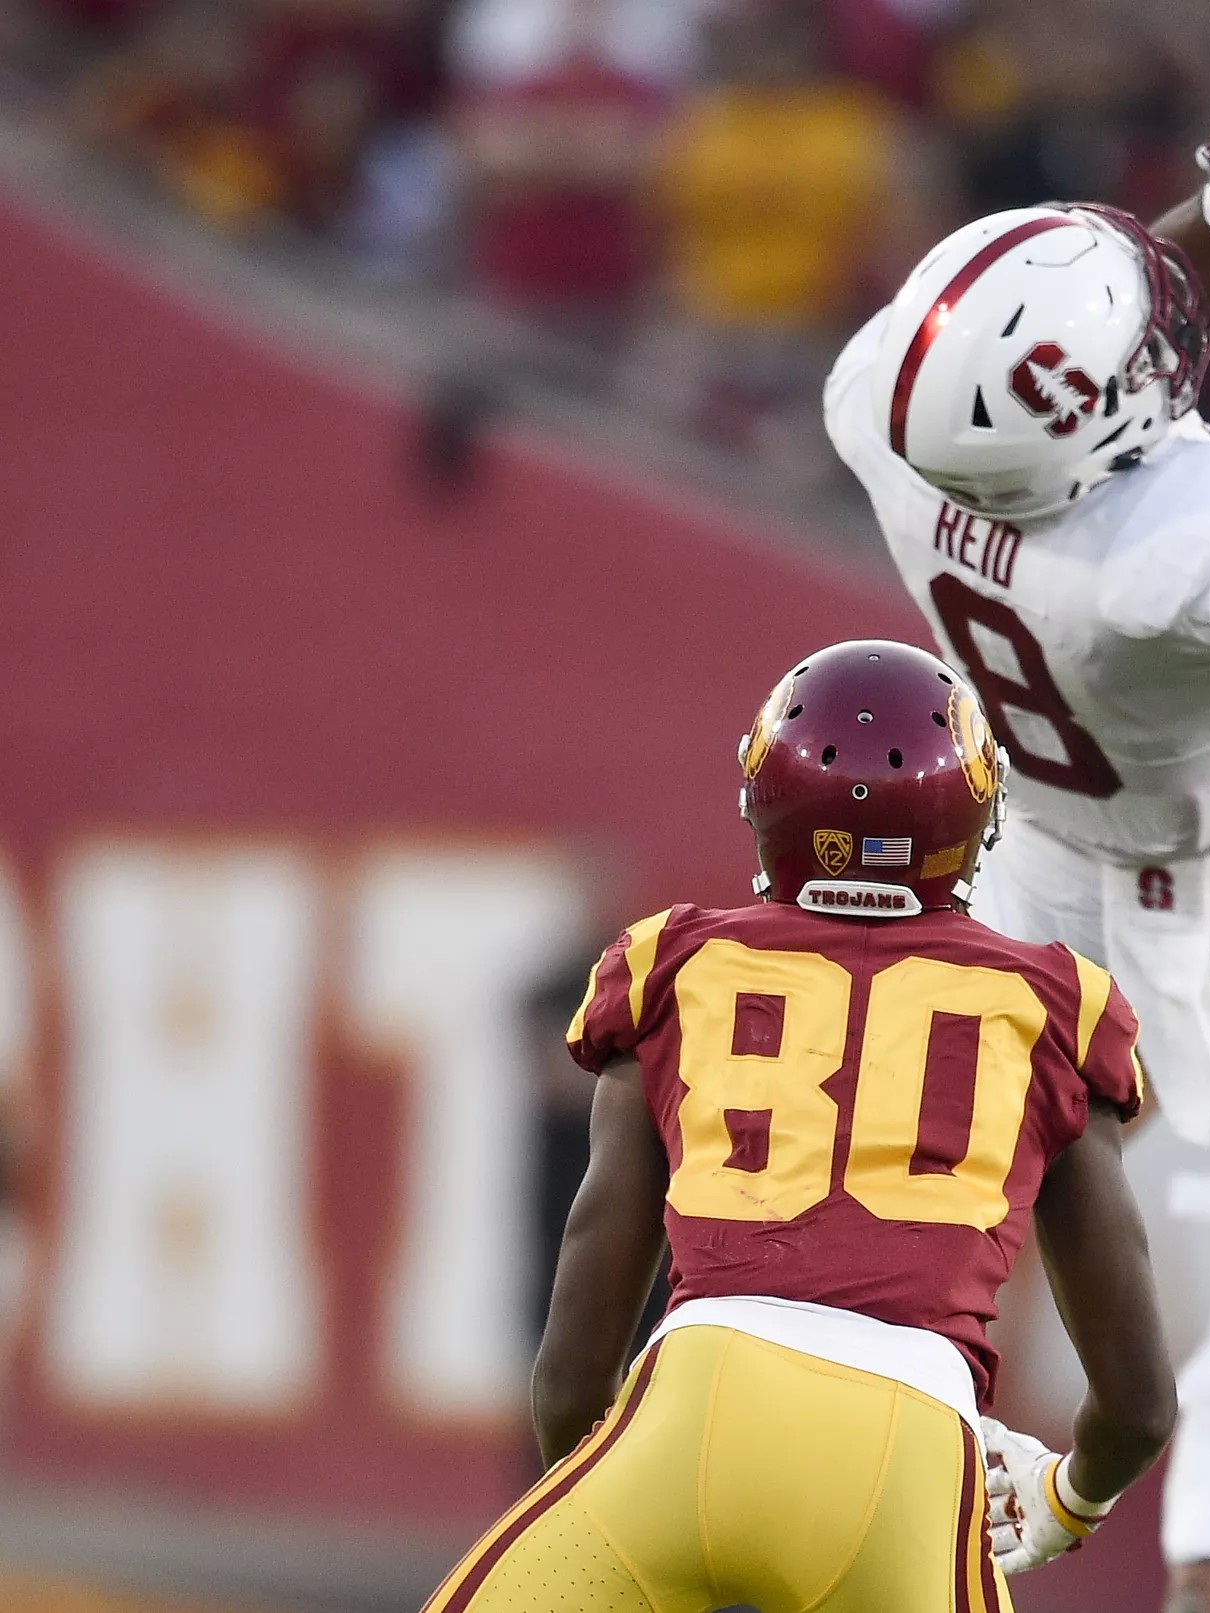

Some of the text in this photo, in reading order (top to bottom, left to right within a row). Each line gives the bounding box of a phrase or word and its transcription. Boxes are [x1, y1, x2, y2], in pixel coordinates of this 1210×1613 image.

[935, 500, 1023, 589] REID
[928, 571, 1125, 801] 8
[816, 833, 851, 858] PAC
[823, 850, 843, 867] 12
[808, 889, 906, 909] TROJANS
[665, 937, 1048, 1233] 80
